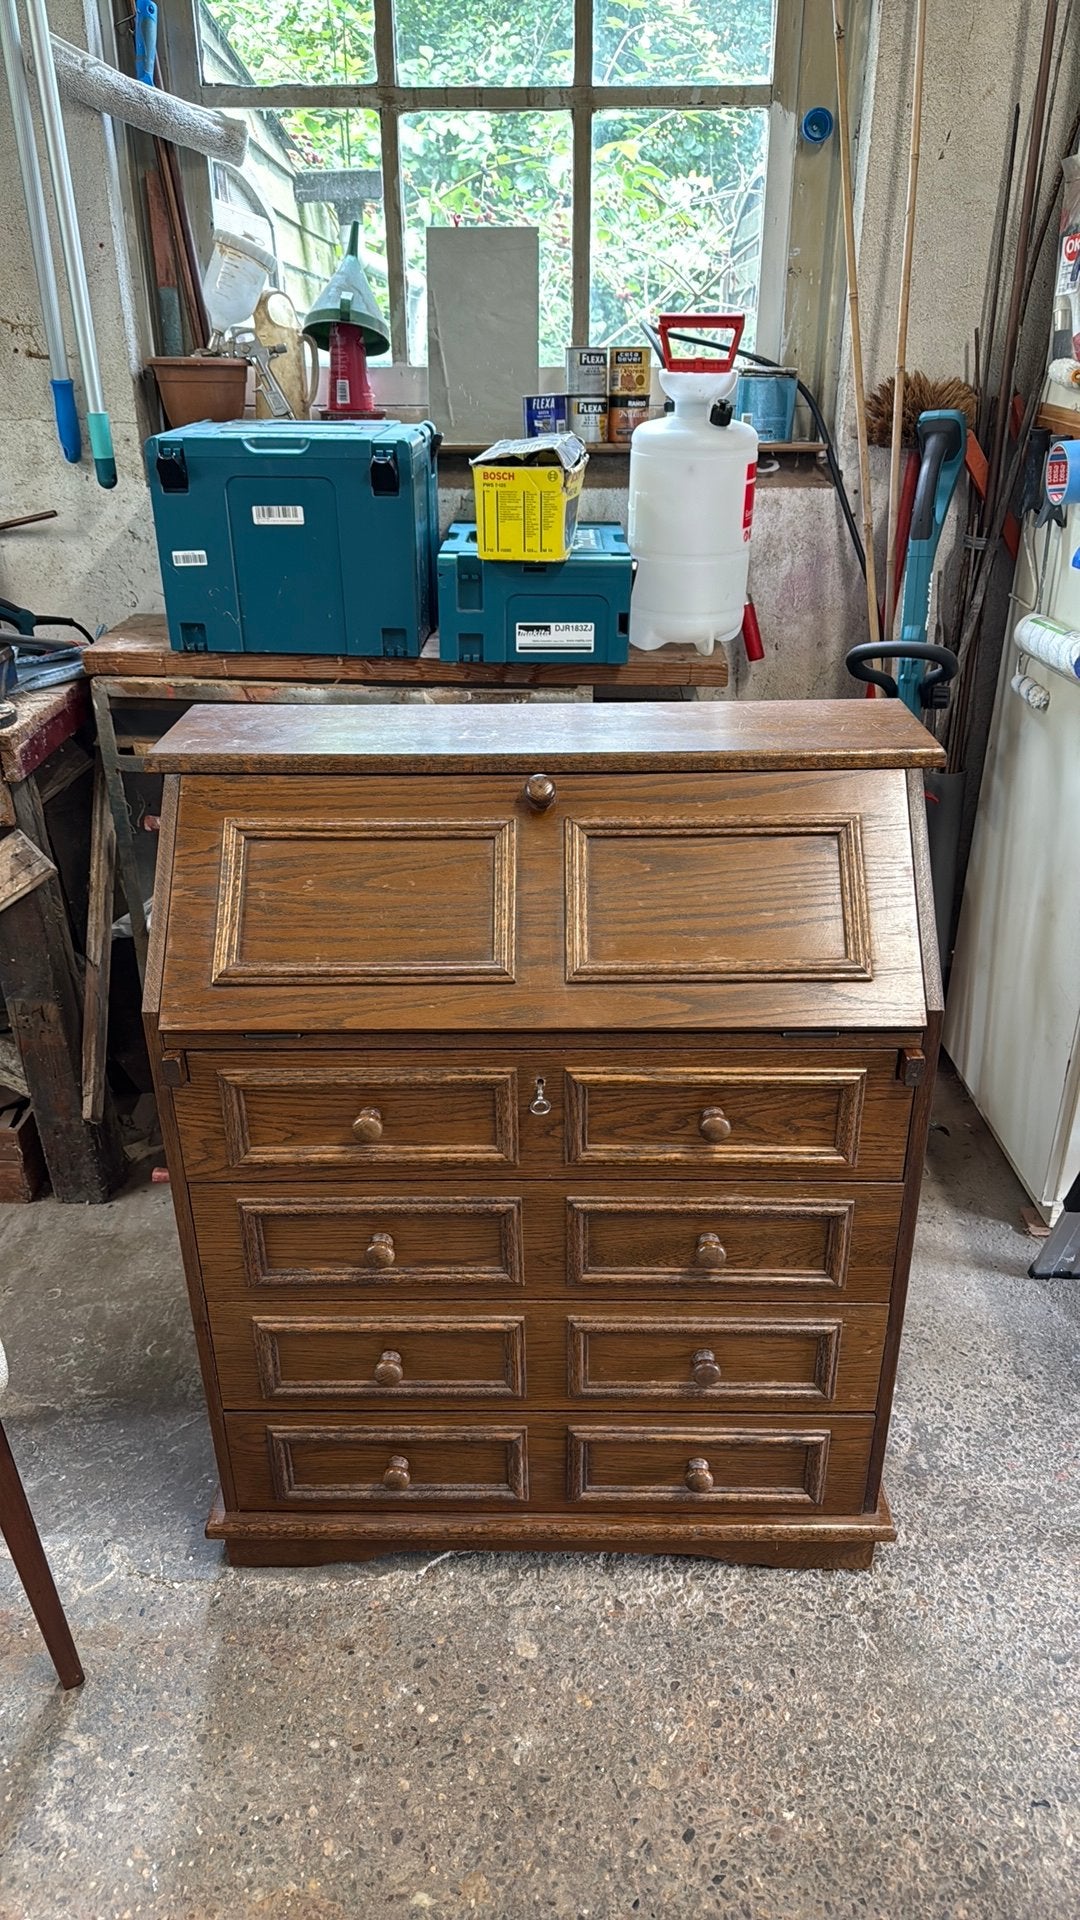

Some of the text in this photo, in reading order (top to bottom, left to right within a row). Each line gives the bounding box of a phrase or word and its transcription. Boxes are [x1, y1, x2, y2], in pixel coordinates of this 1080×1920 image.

[581, 353, 605, 364] FLEXA
[532, 398, 556, 410] FLEXA
[579, 403, 603, 413] FLEXA
[483, 472, 515, 480] BOSCH
[554, 624, 593, 632] DJR183ZJ
